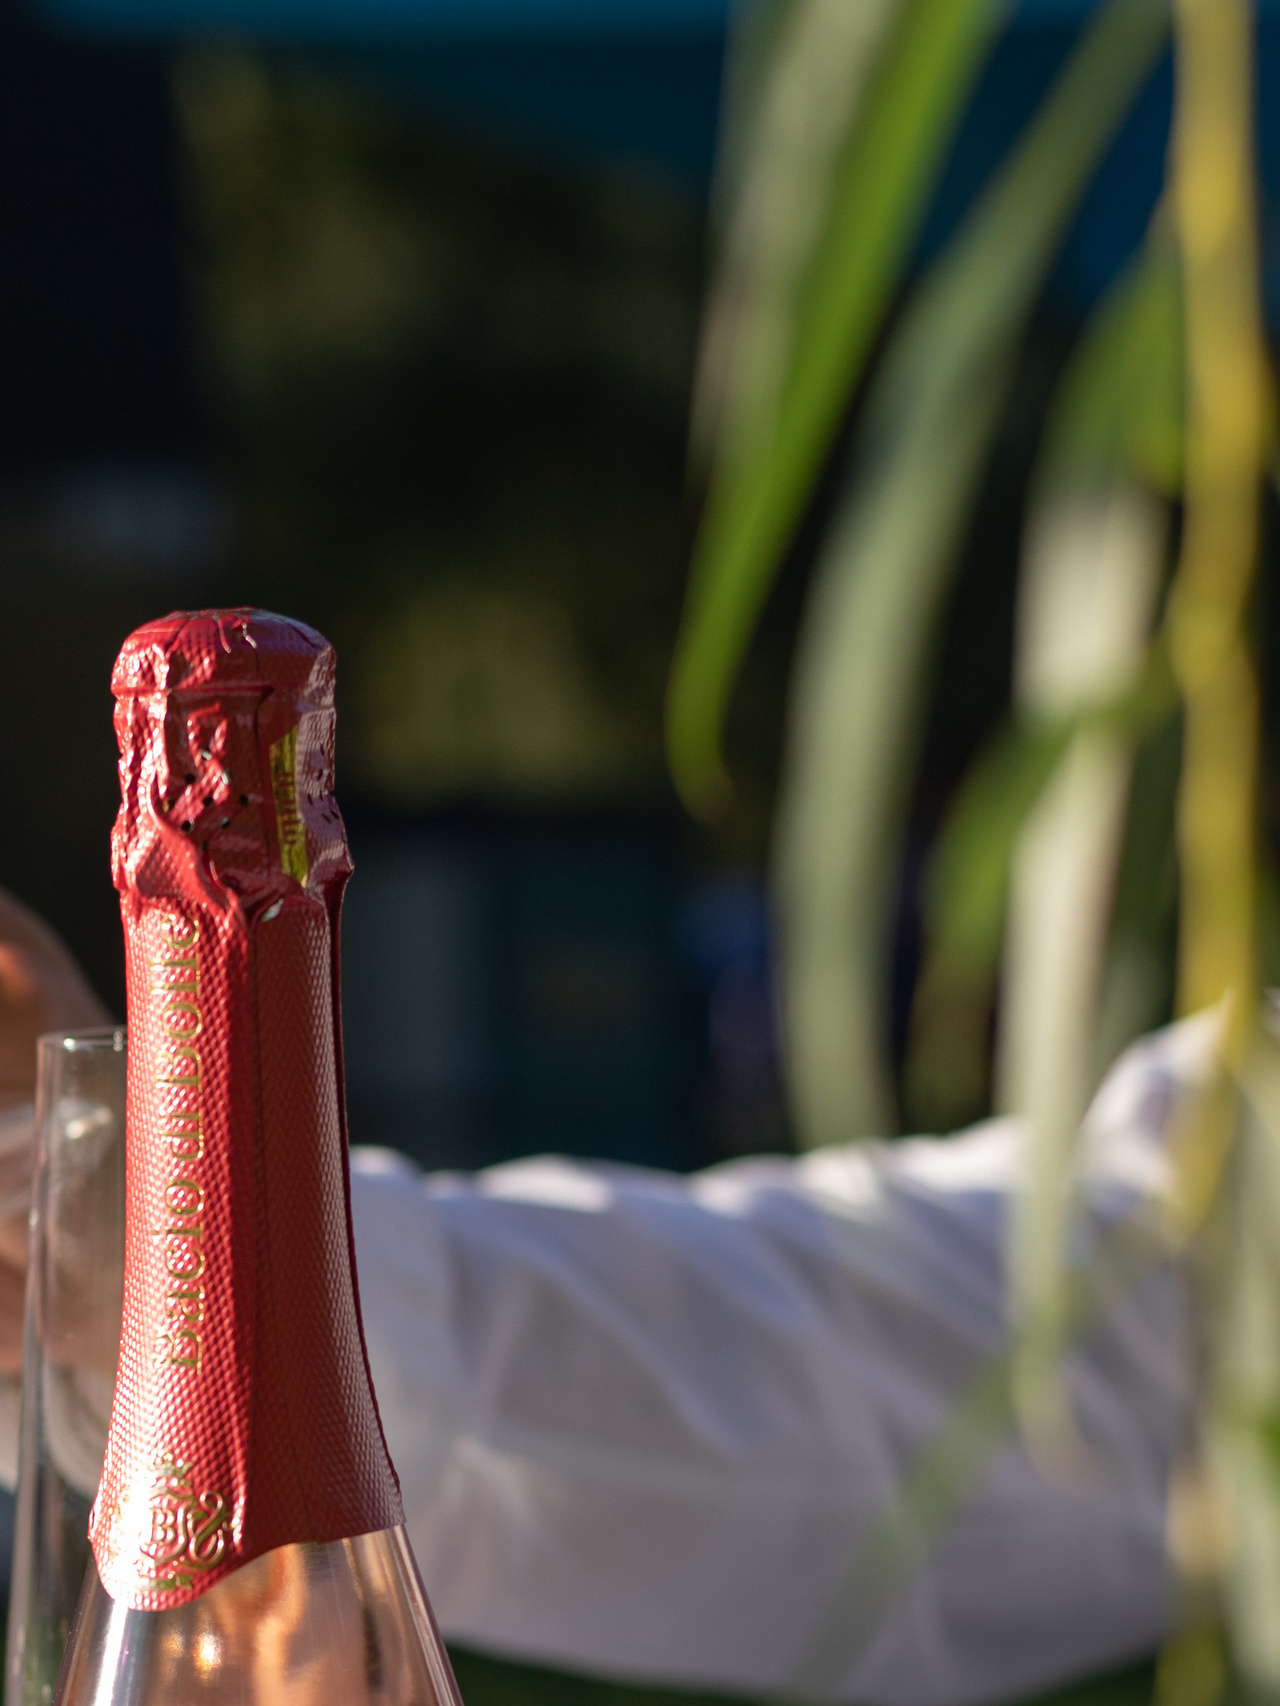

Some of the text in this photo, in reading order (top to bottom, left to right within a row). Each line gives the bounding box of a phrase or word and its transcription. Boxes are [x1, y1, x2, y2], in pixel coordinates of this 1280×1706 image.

[149, 912, 204, 1375] Bacio di Bolle
